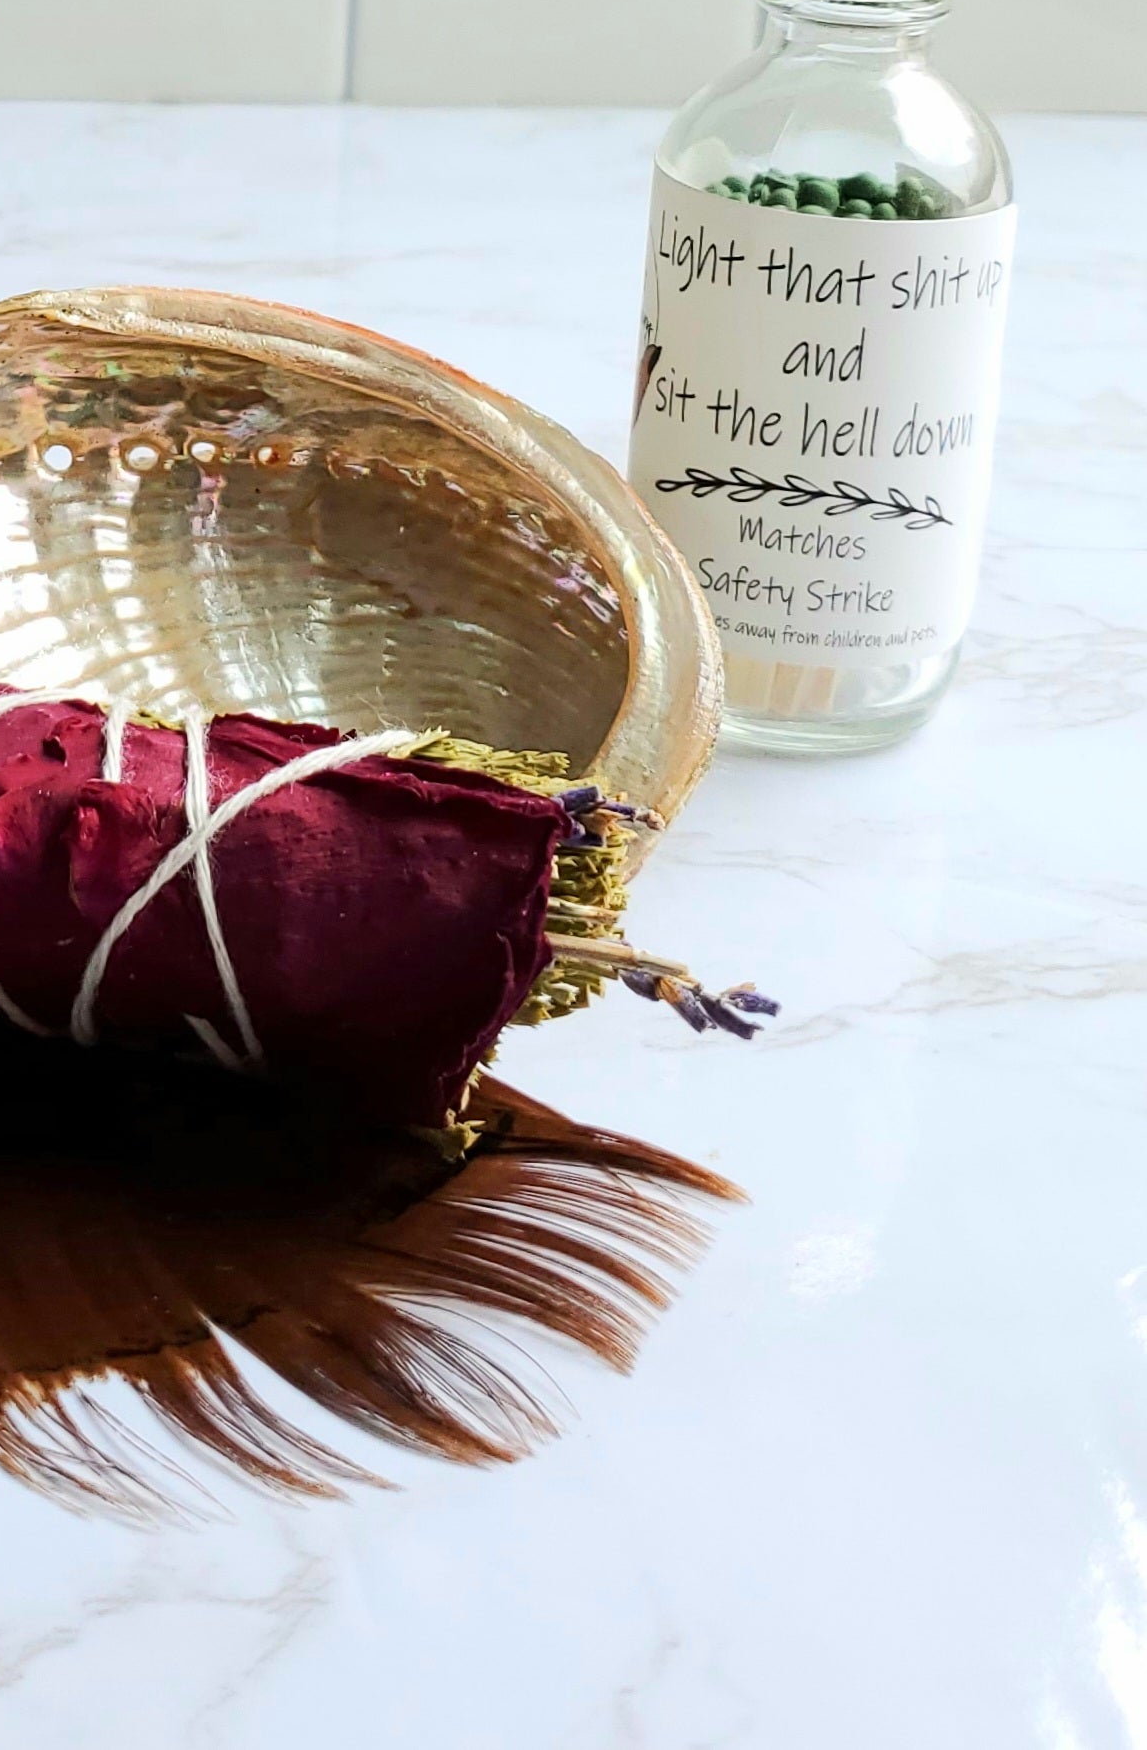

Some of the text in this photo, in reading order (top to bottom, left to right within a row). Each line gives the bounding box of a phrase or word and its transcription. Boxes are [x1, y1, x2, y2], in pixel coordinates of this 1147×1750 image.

[659, 210, 1004, 310] Light that shit up
[782, 326, 866, 382] and
[655, 367, 975, 458] sit the hell down
[739, 514, 867, 560] Matches
[697, 557, 894, 616] Safety Strike
[735, 621, 776, 645] away
[782, 624, 819, 645] from
[824, 629, 882, 648] children
[885, 625, 907, 647] and
